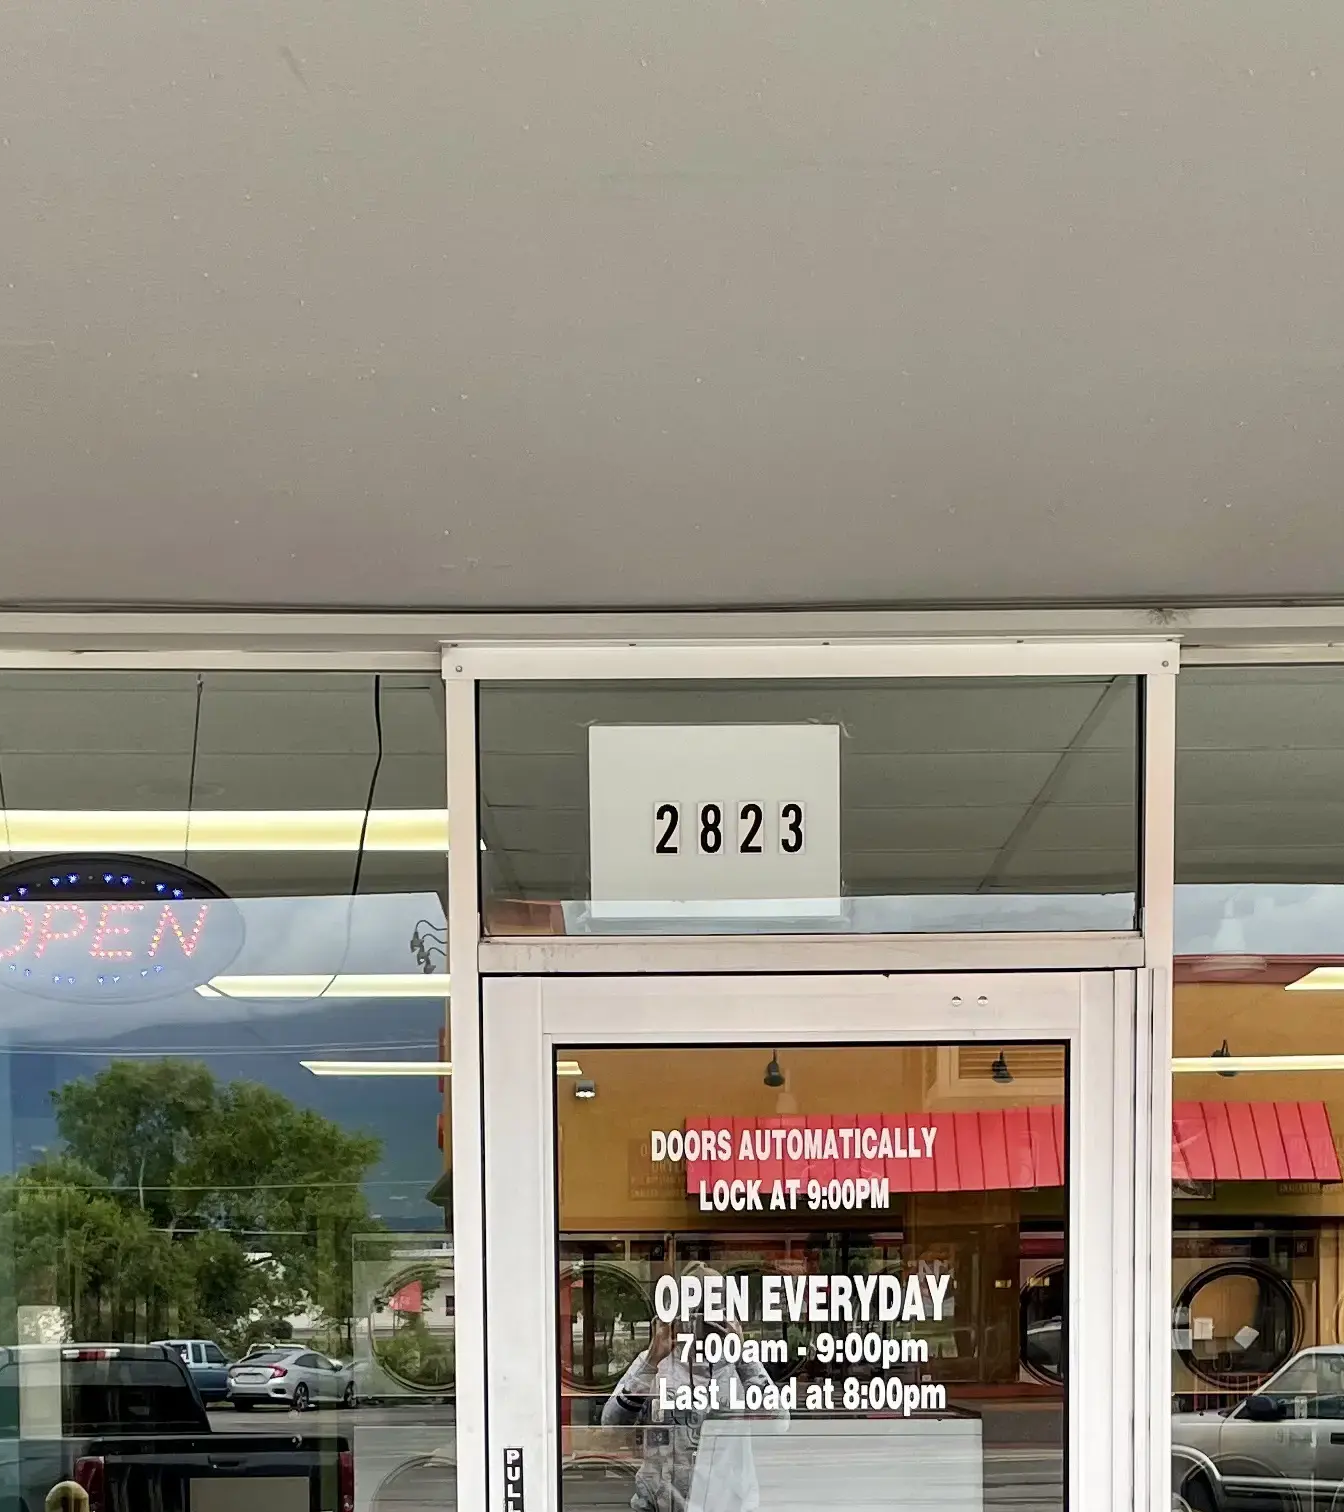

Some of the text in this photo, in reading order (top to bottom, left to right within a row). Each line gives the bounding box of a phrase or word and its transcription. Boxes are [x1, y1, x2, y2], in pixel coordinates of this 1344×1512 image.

[656, 804, 803, 853] 2823
[652, 1128, 732, 1161] DOORS
[739, 1127, 937, 1161] AUTOMATICALLY
[700, 1178, 889, 1210] LOCK AT 9:00PM
[654, 1275, 951, 1323] OPEN EVERYDAY
[677, 1333, 788, 1363] 7:00am
[817, 1333, 928, 1369] 9:00pm
[659, 1374, 947, 1417] Last Load at 8:00pm
